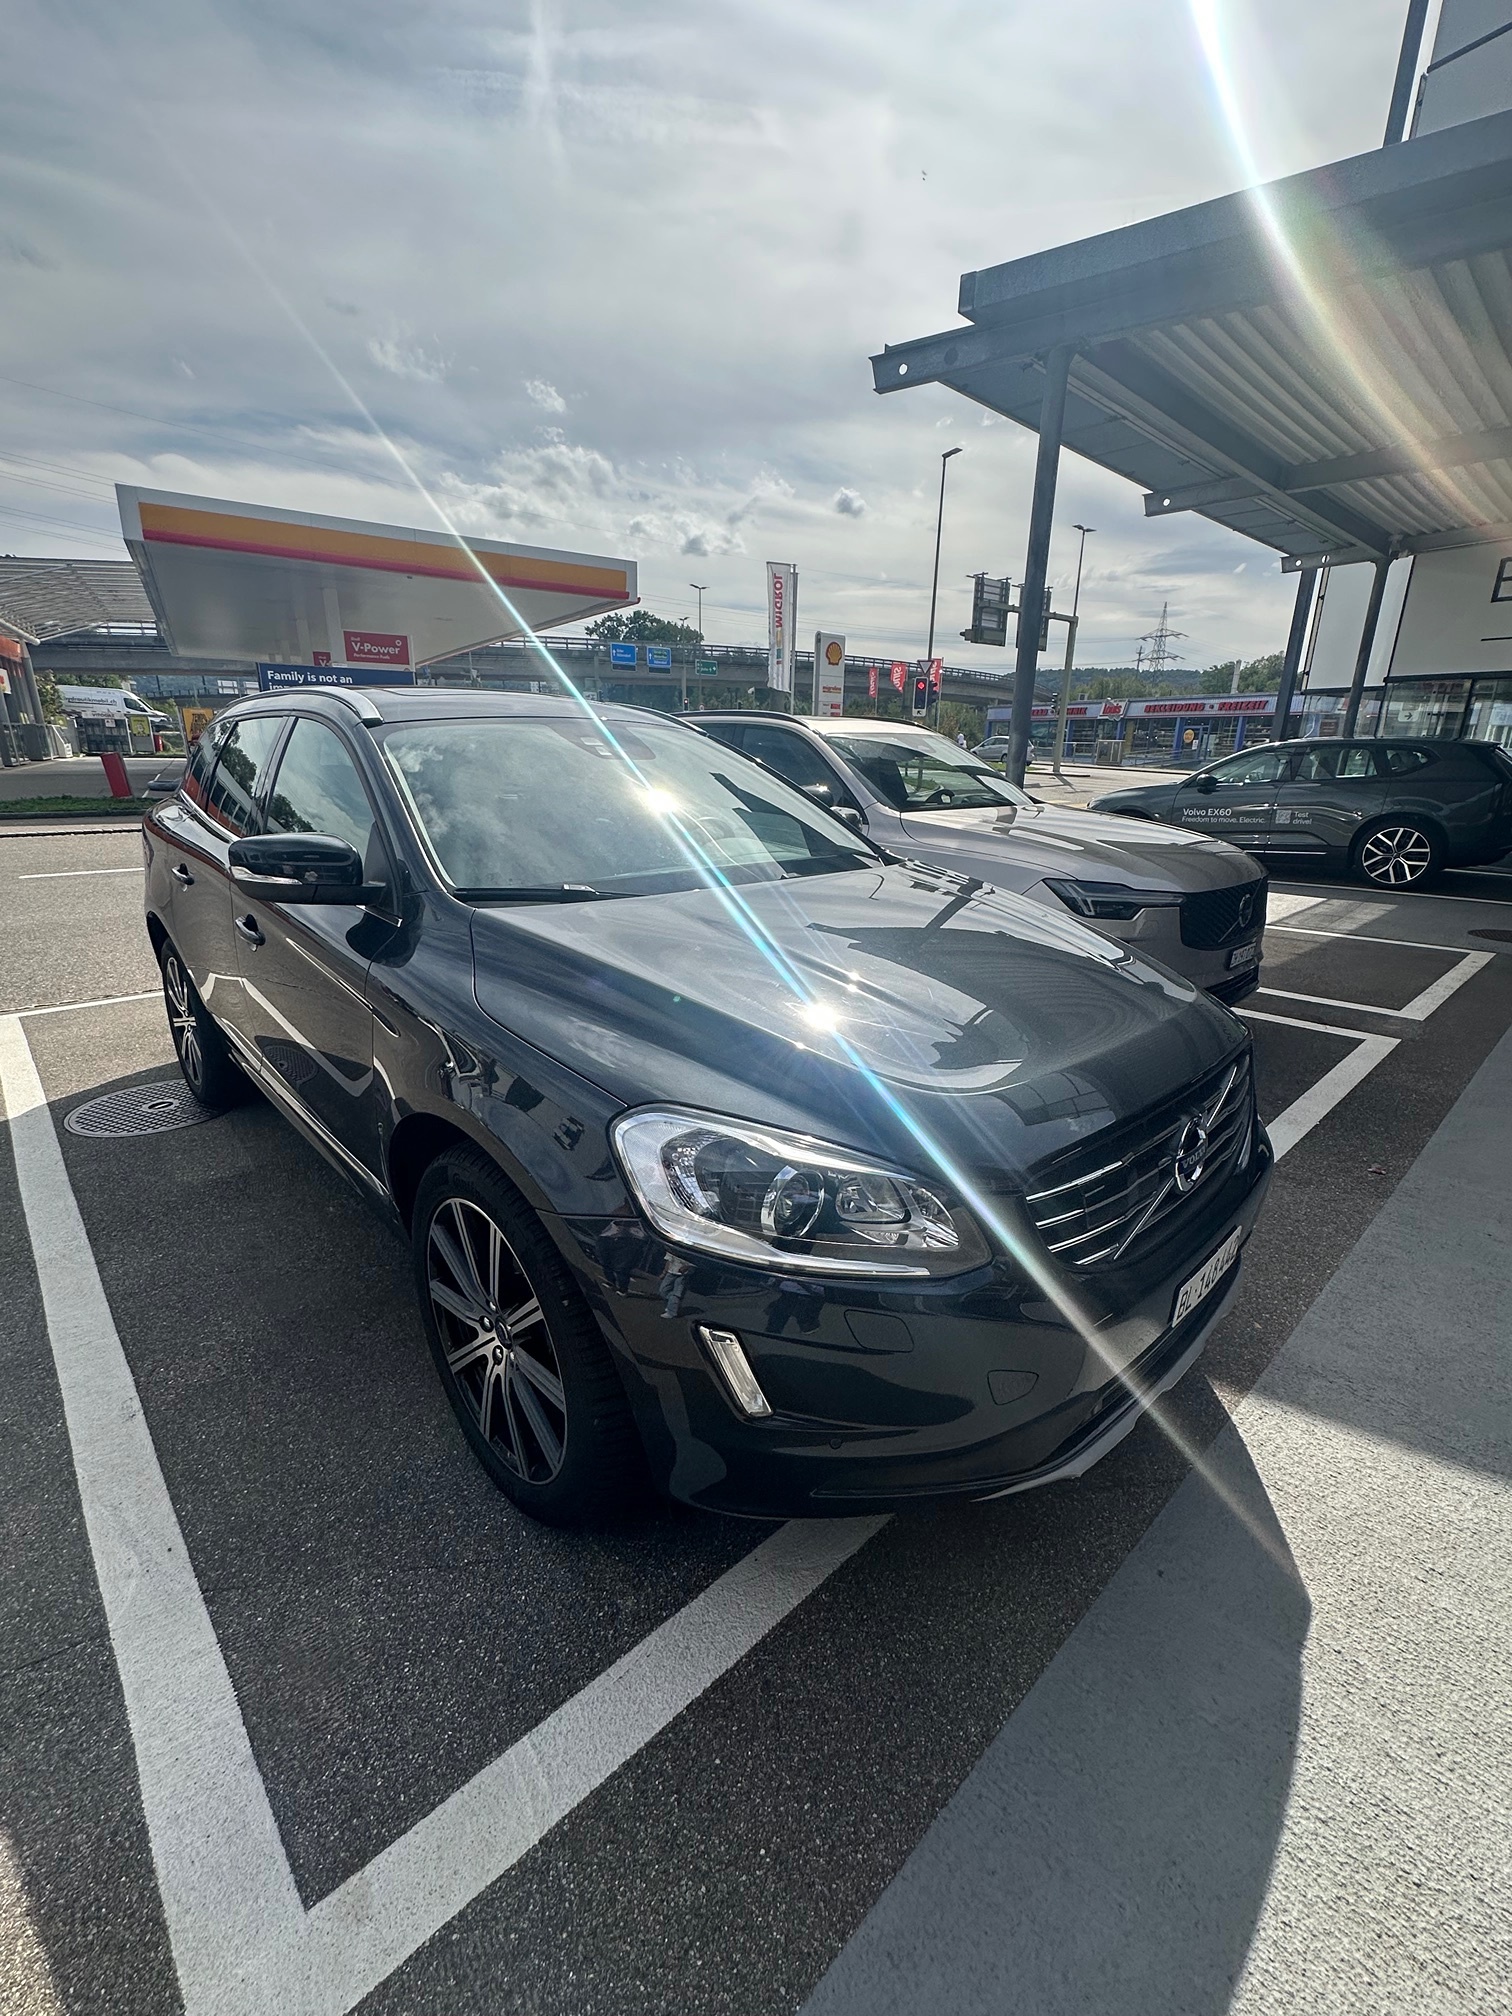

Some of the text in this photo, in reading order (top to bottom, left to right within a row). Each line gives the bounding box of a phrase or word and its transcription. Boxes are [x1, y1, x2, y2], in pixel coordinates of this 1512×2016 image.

[351, 641, 401, 654] V-Power
[267, 670, 353, 684] Family is not an
[1144, 700, 1269, 714] BEKLEIDUNG FREIZEIT
[1182, 807, 1232, 816] Volvo EX60
